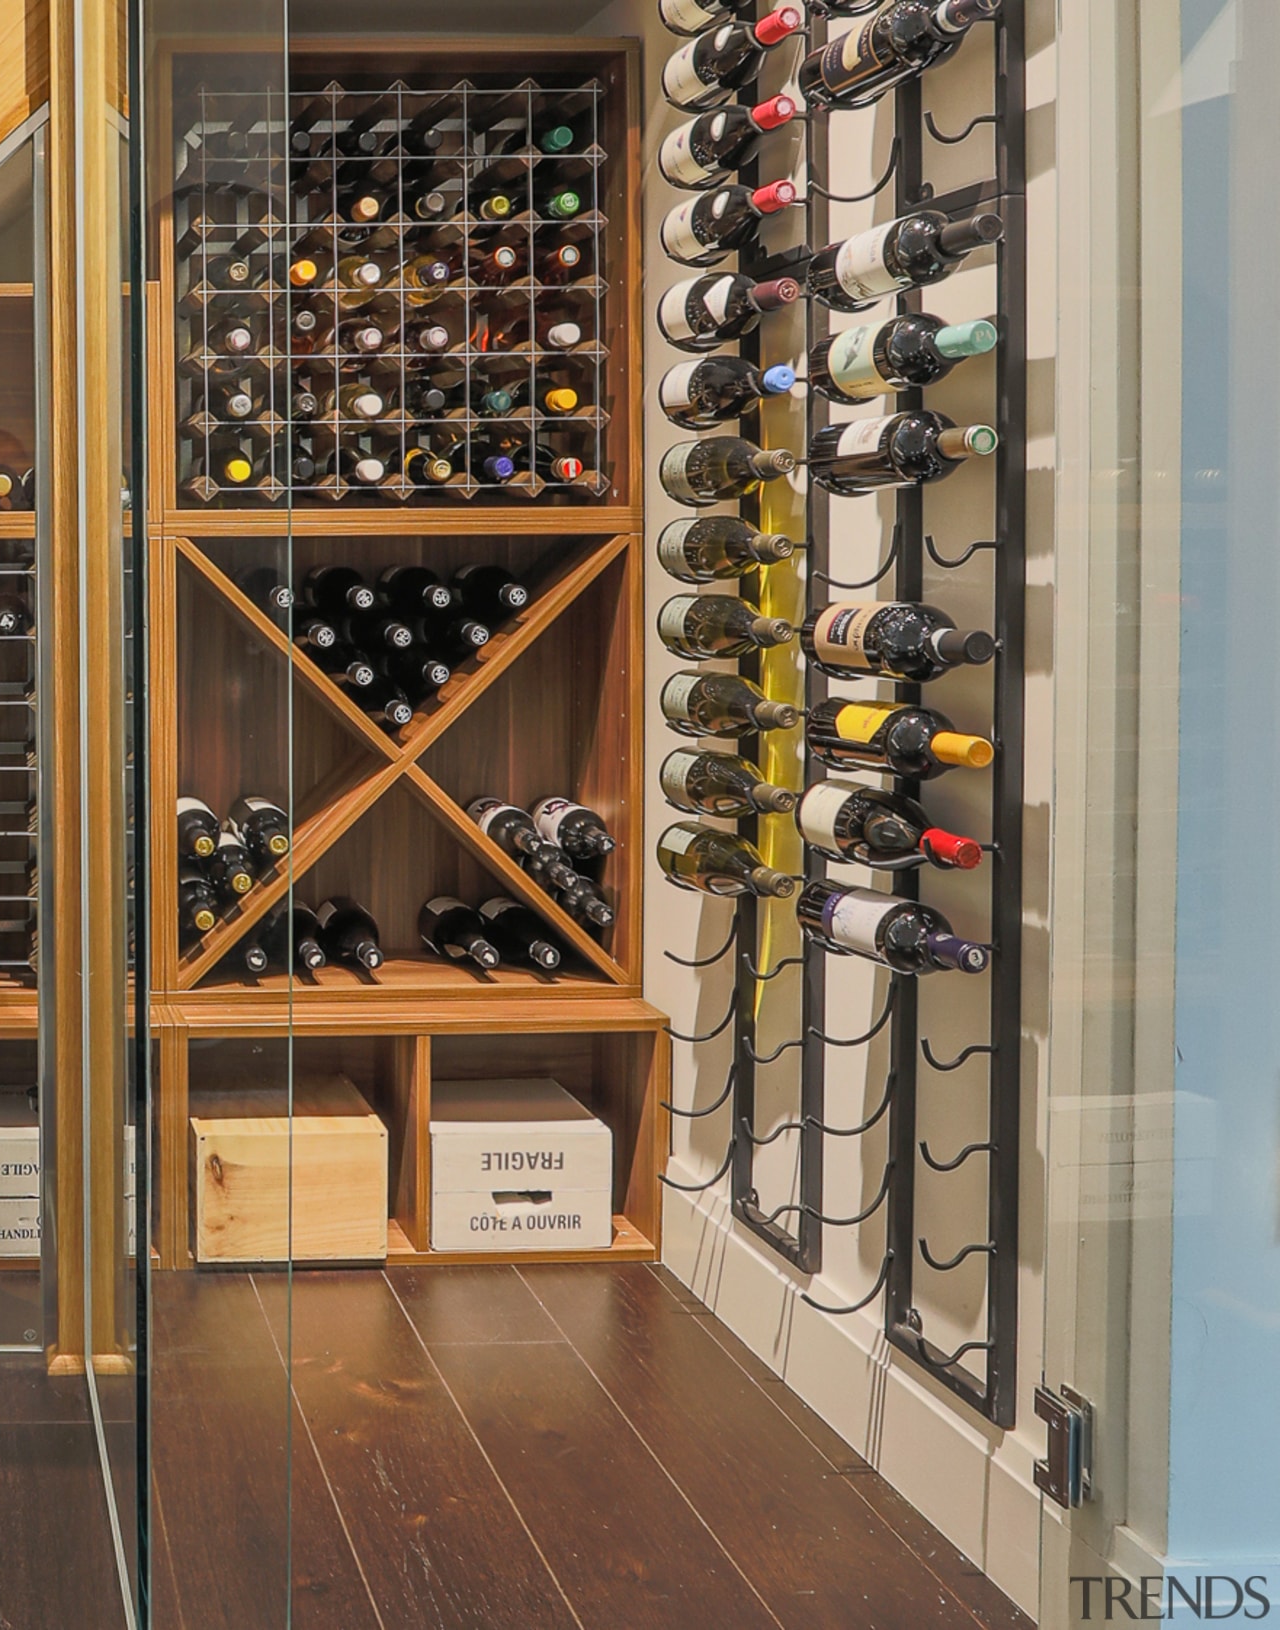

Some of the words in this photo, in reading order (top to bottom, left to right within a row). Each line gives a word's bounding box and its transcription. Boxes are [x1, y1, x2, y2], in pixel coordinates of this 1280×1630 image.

[1, 1163, 40, 1176] AGILE
[481, 1152, 564, 1171] FRAGILE
[512, 1215, 523, 1231] A
[526, 1214, 582, 1231] OUVRIR
